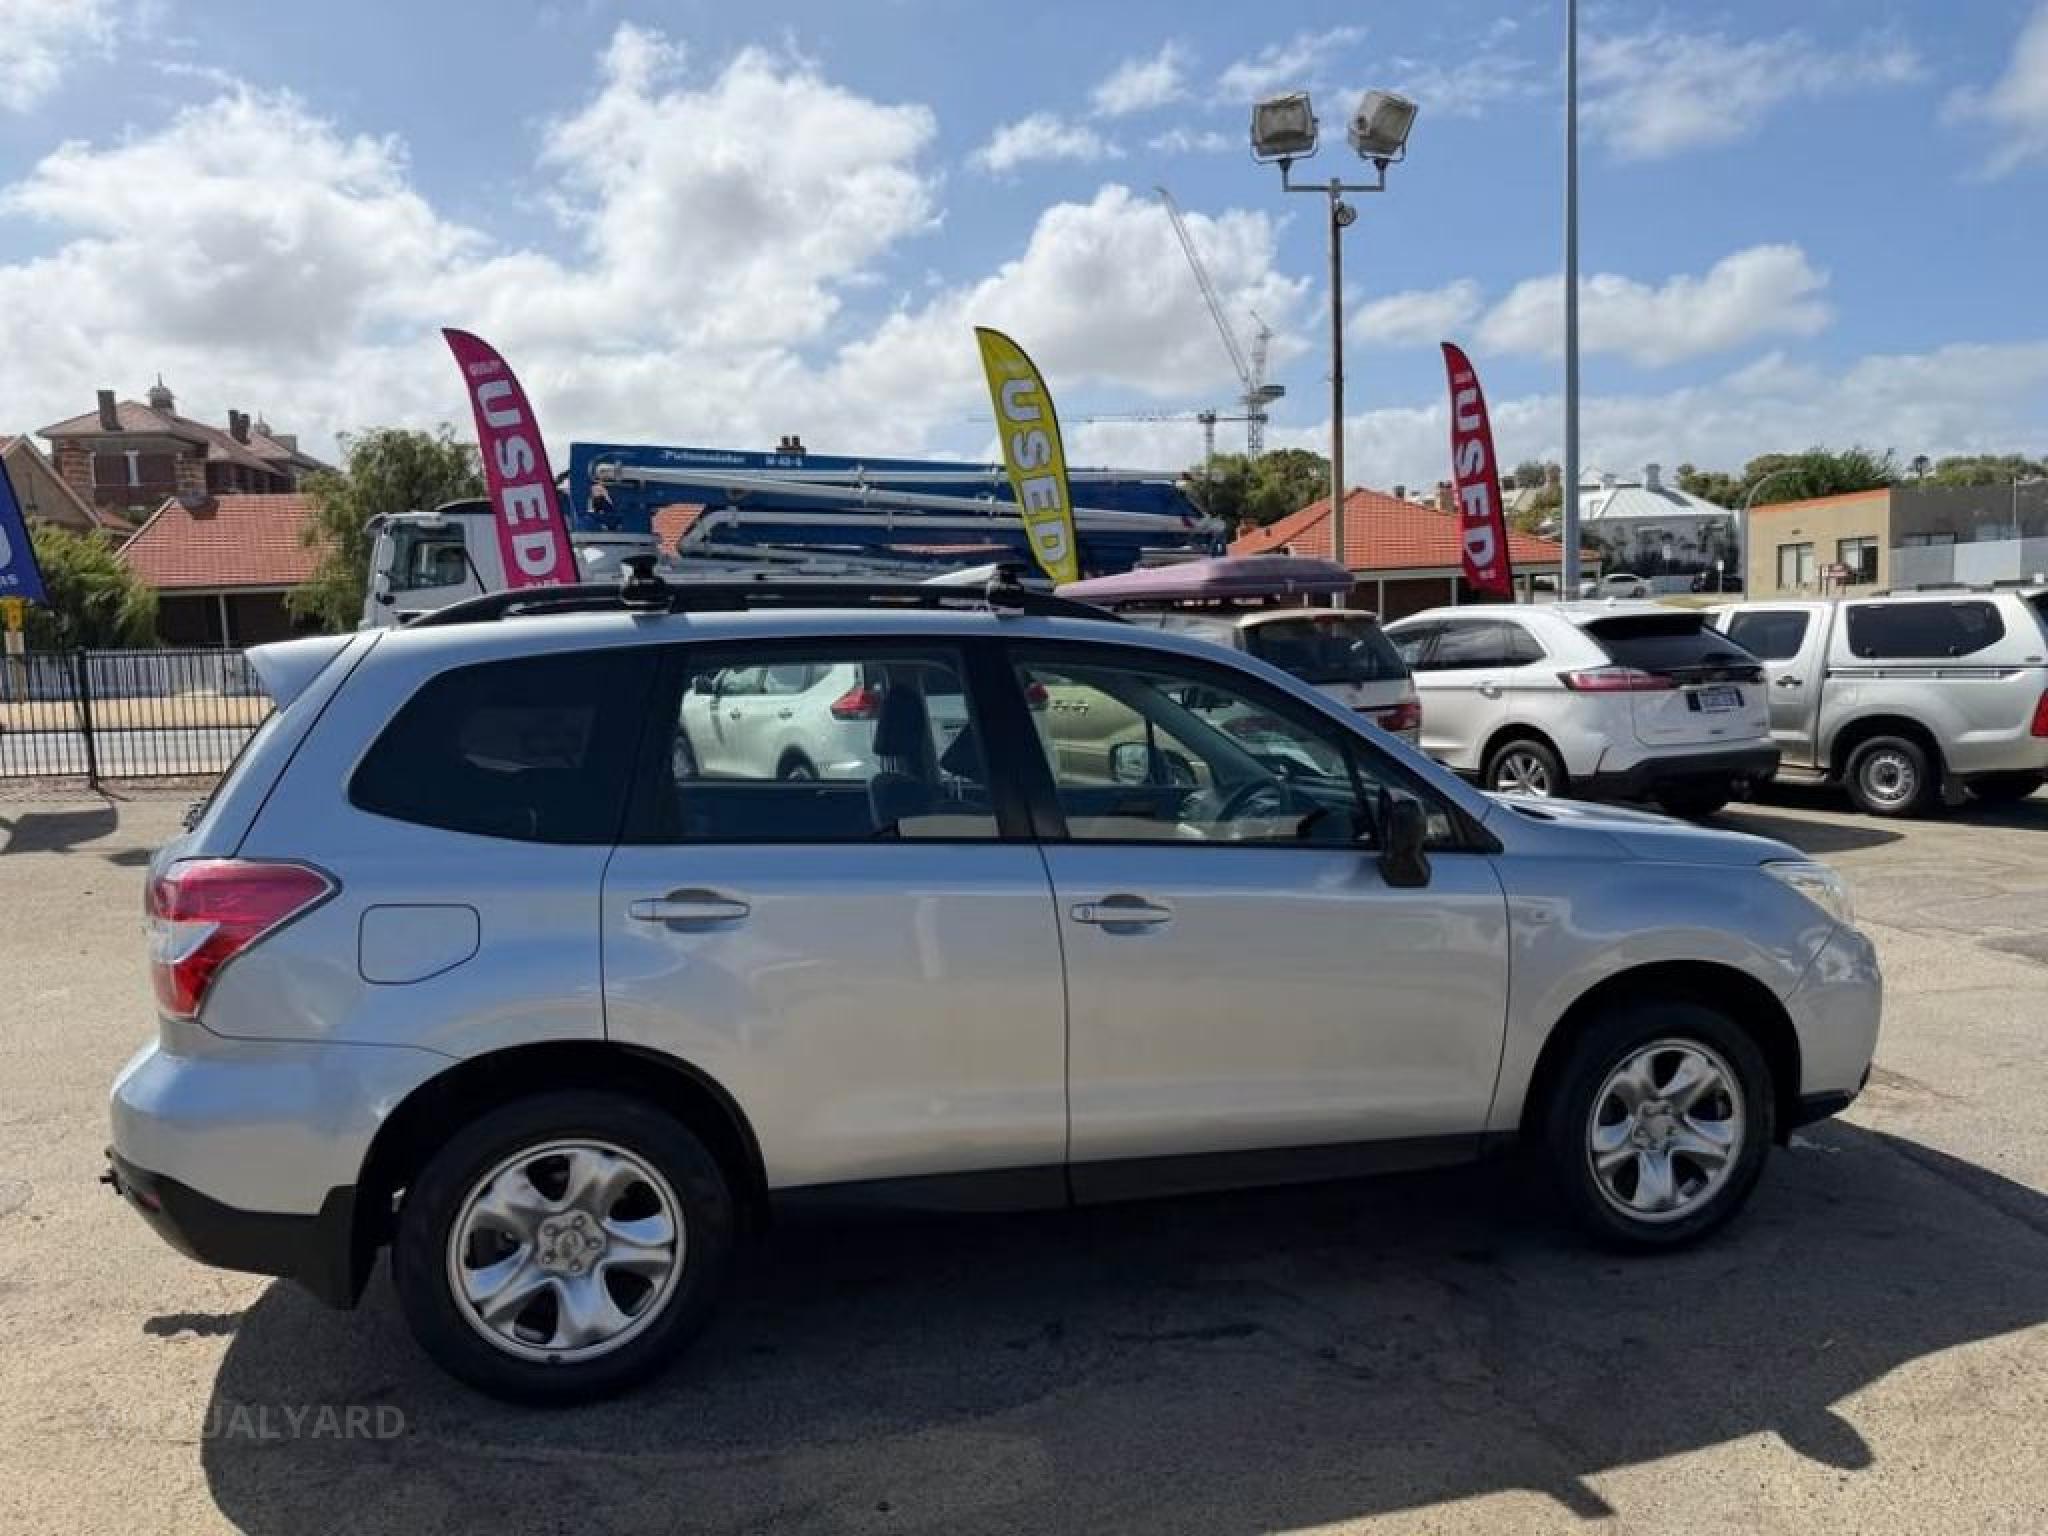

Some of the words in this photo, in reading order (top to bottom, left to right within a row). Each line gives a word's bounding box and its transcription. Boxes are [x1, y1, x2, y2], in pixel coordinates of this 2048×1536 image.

[477, 379, 557, 576] USED
[1001, 378, 1067, 562] USED
[1454, 387, 1495, 568] USED
